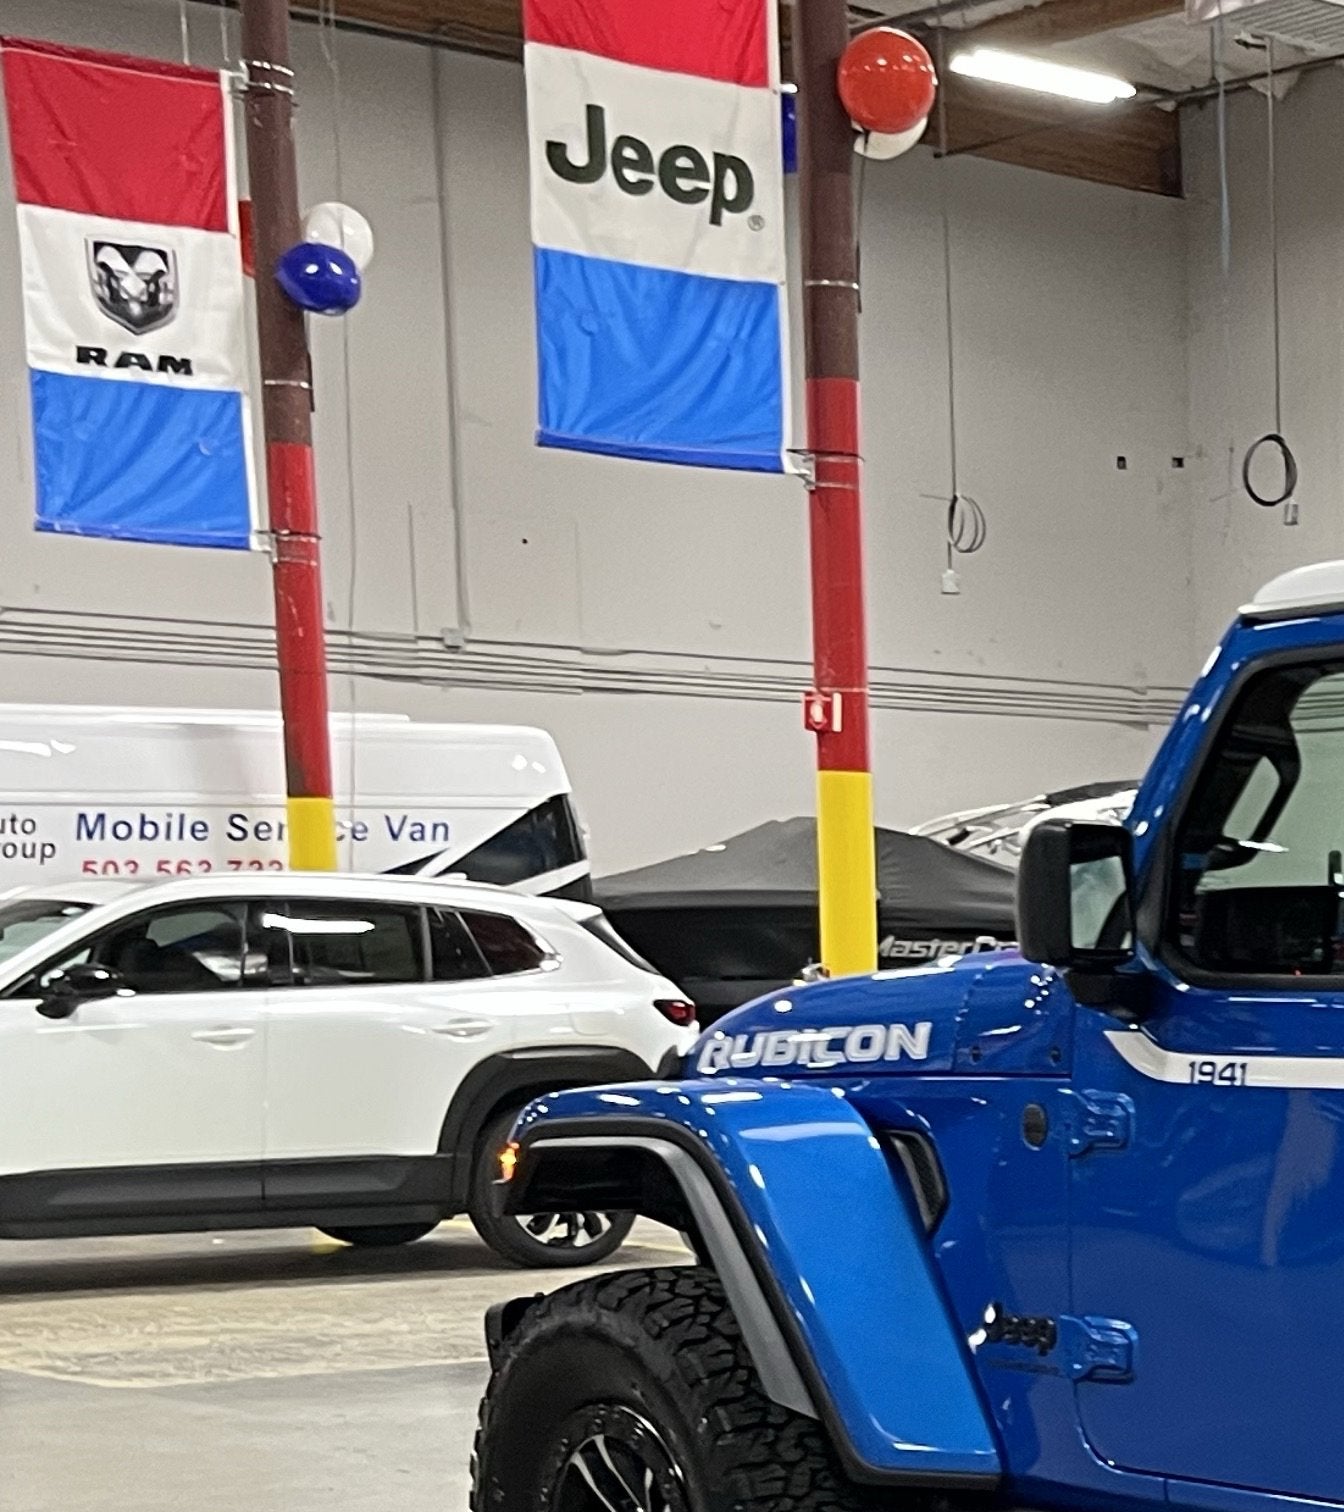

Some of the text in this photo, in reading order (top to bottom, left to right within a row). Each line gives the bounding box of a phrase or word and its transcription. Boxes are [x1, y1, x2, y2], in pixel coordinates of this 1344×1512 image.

[545, 103, 755, 227] Jeep
[75, 344, 194, 376] RAM
[76, 812, 210, 842] Mobile
[384, 814, 450, 842] Van
[698, 1021, 933, 1074] RUBICON
[1188, 1060, 1247, 1086] 1941
